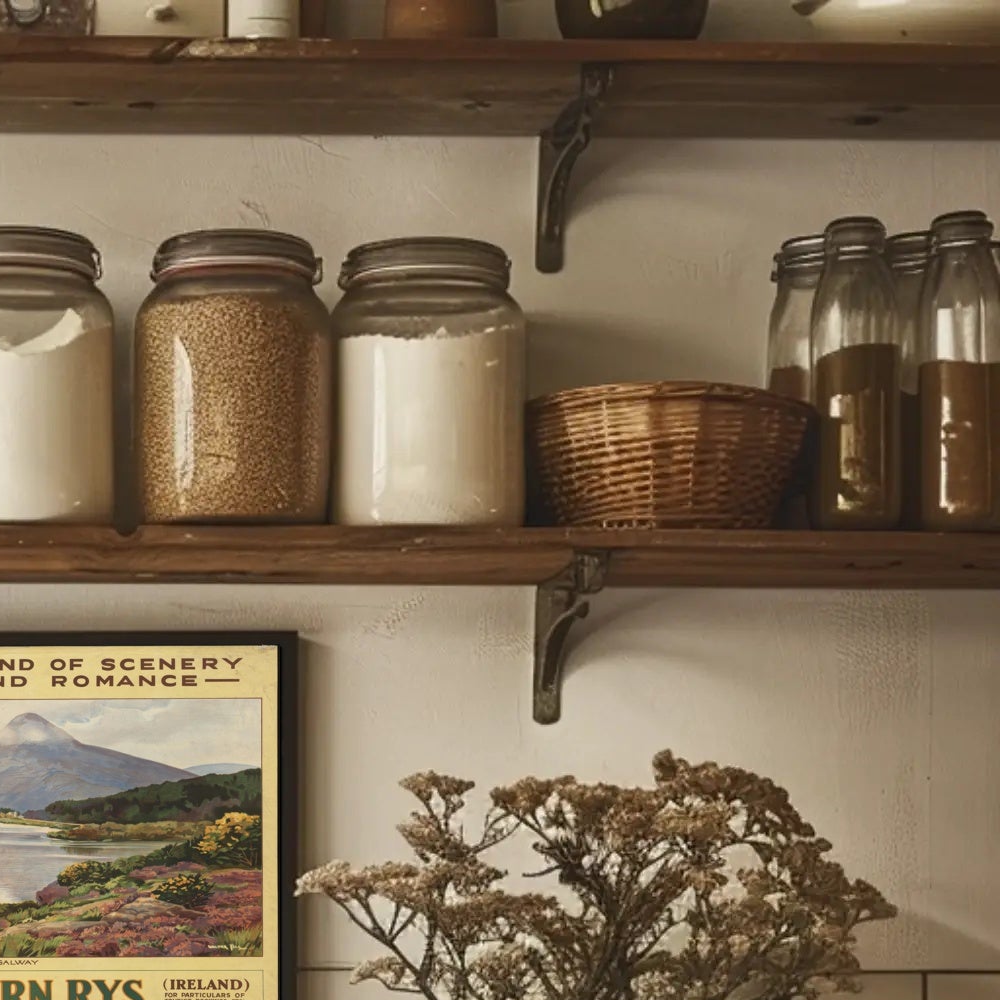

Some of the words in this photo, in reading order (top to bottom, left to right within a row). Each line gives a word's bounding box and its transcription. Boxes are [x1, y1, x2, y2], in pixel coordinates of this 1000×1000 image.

[50, 658, 84, 671] OF
[101, 657, 243, 671] SCENERY
[163, 978, 250, 992] (IRELAND)
